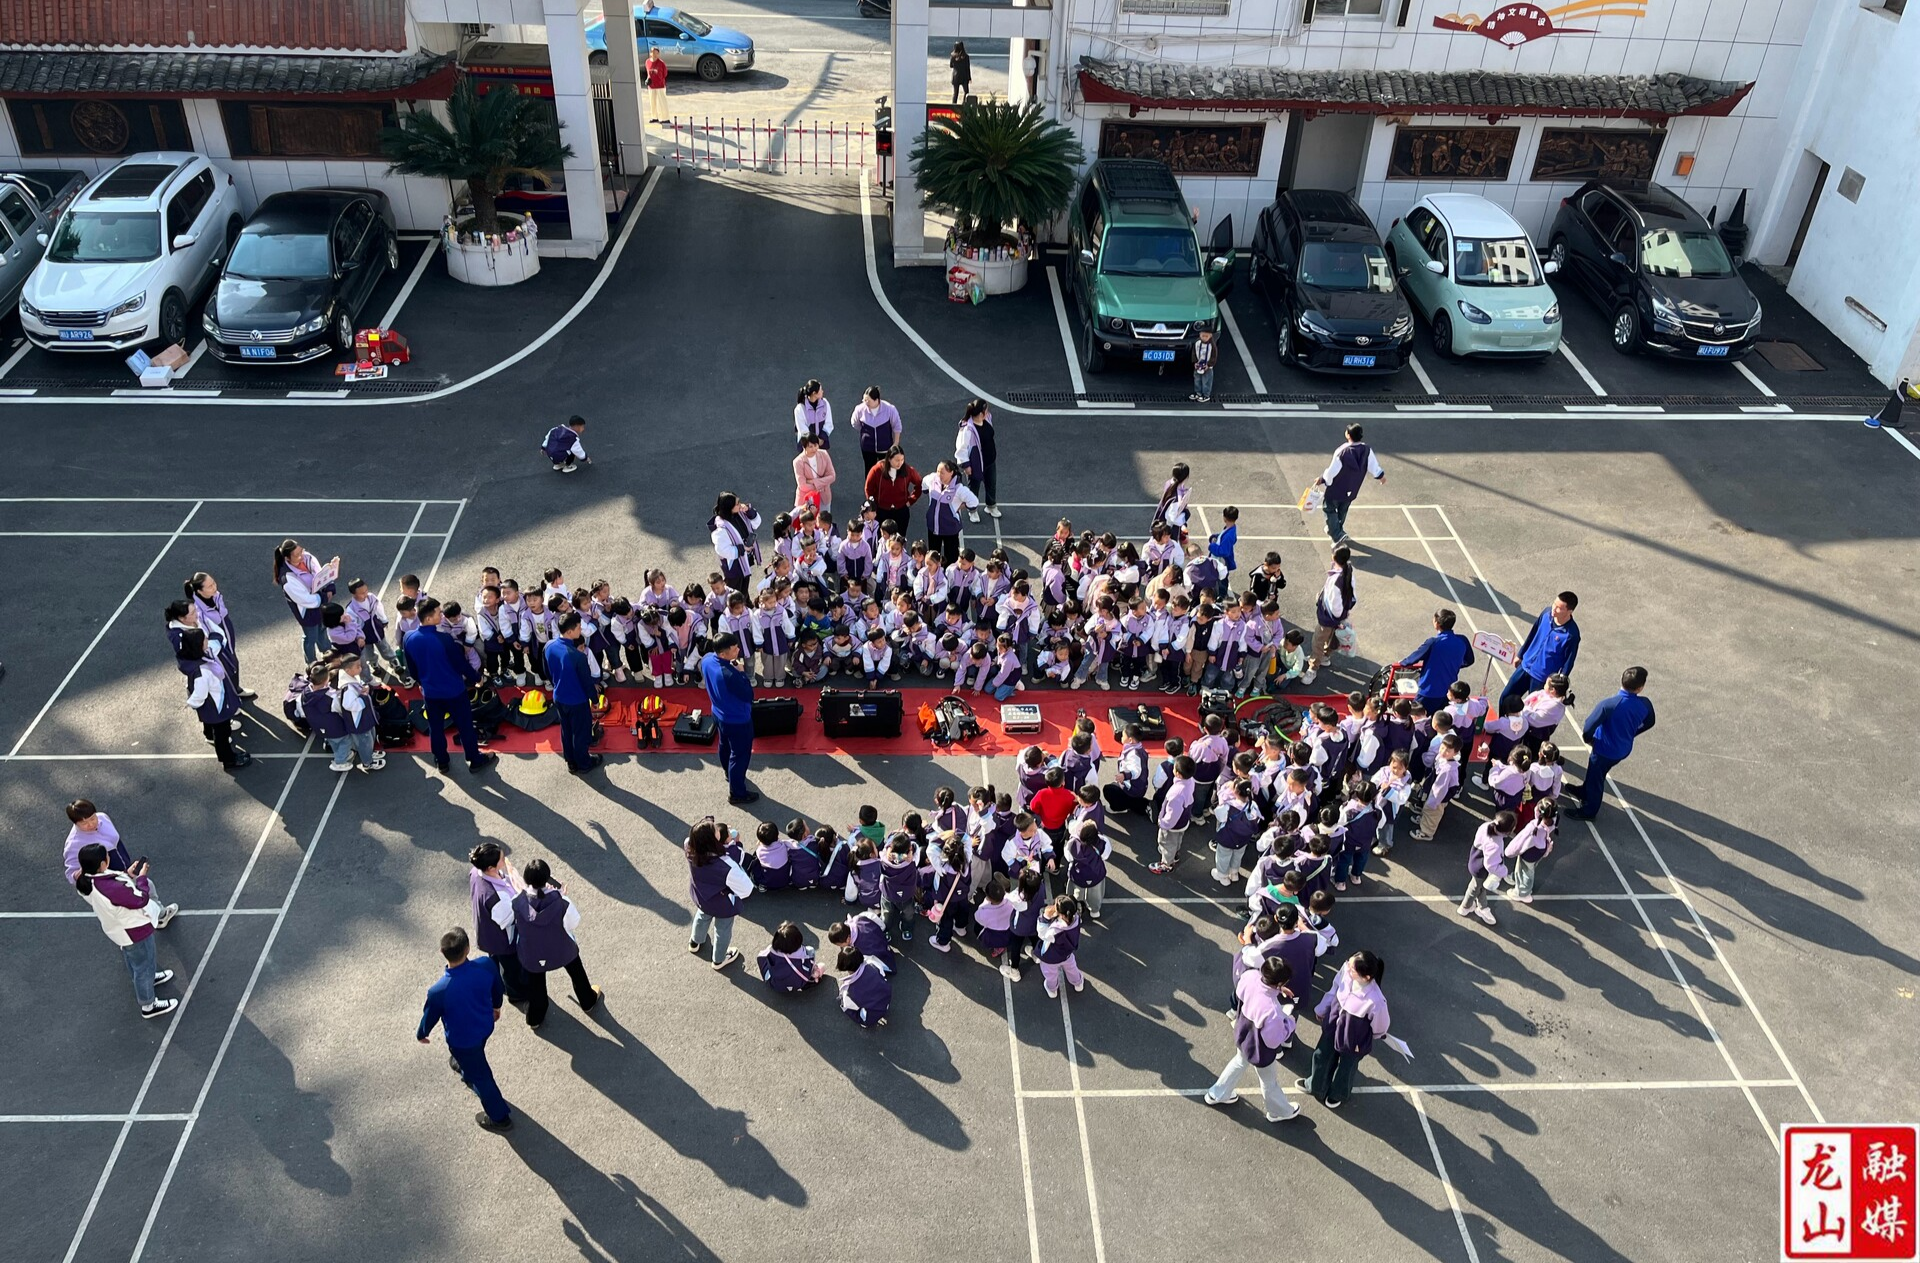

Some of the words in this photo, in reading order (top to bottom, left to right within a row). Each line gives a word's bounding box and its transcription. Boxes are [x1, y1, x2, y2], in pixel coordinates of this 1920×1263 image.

[1486, 7, 1546, 30] 精神文明建设
